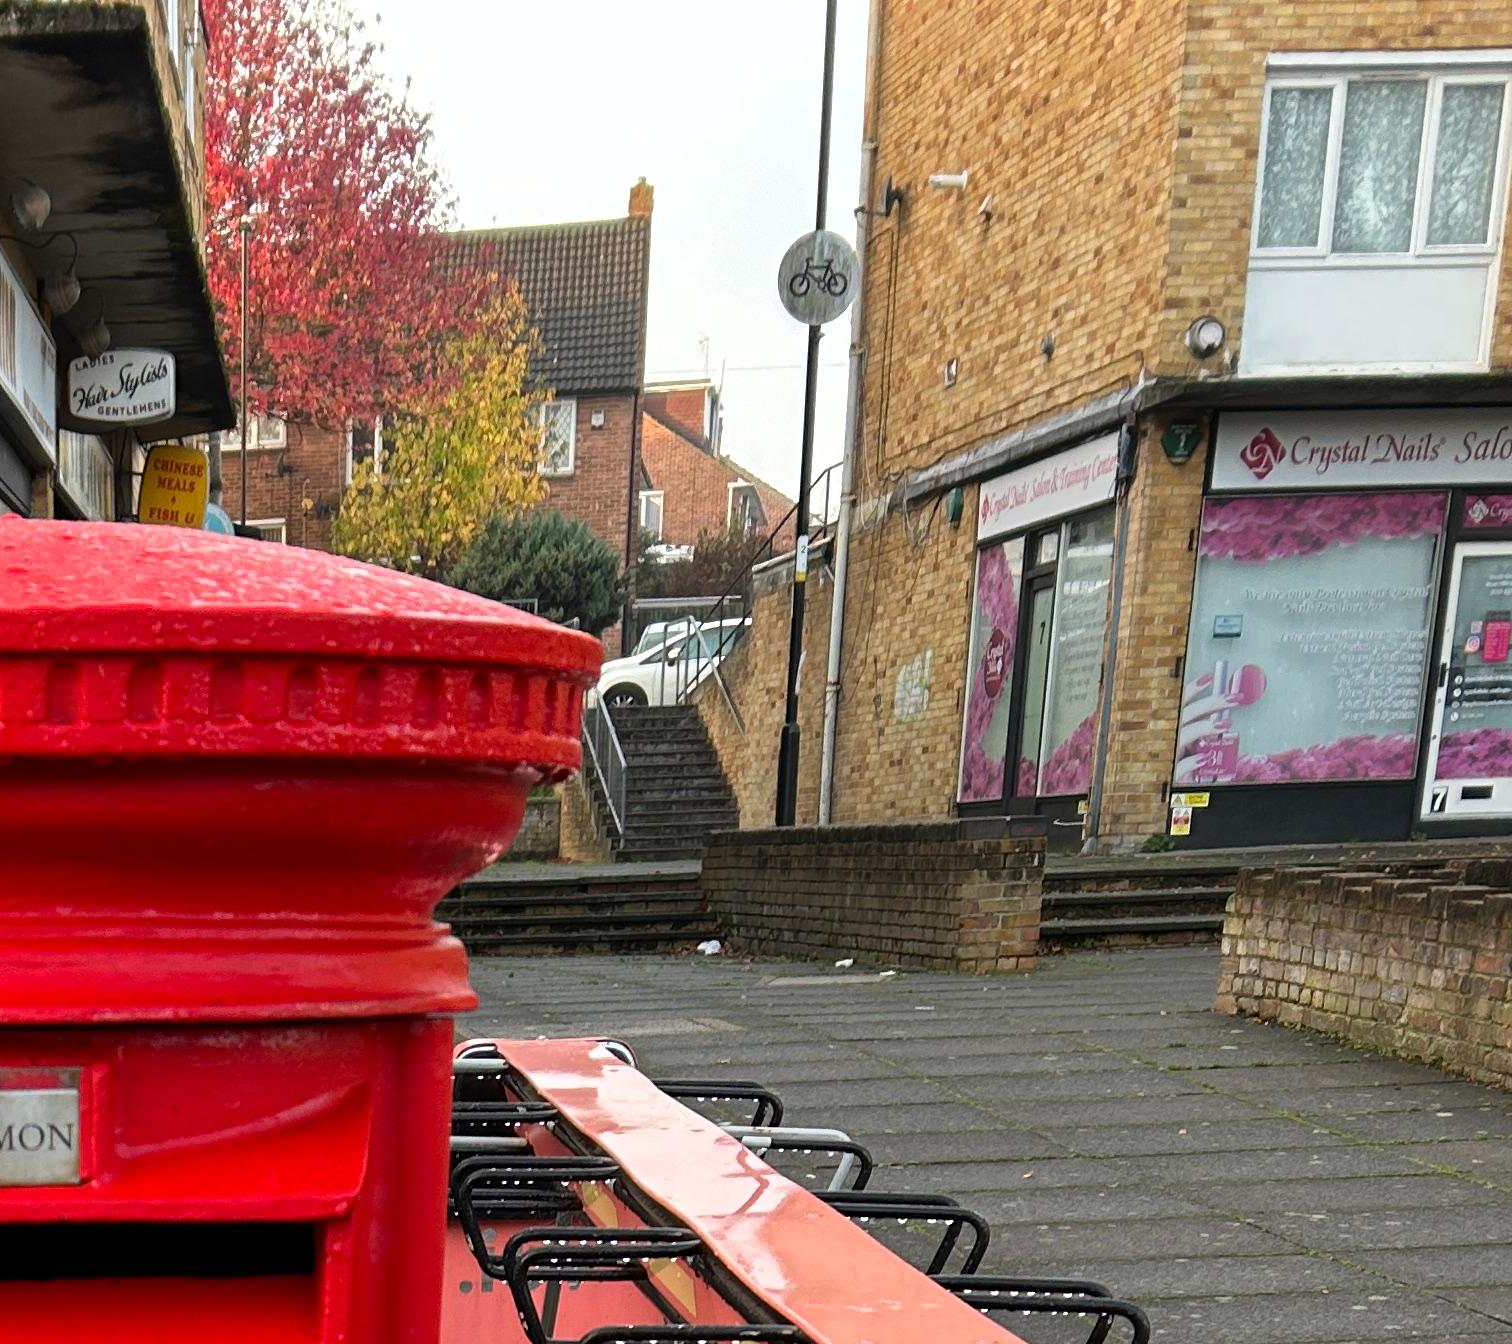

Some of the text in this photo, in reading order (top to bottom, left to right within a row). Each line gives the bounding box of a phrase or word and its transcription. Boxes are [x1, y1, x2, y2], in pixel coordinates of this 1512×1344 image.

[74, 354, 115, 372] LADIES
[72, 357, 169, 413] Hair Stylists
[97, 398, 167, 416] GENTLEMENS
[1290, 433, 1372, 476] Crystal
[153, 459, 205, 478] CHINESE
[156, 475, 197, 493] MEALS
[148, 507, 180, 522] FISH
[1433, 787, 1447, 811] 7
